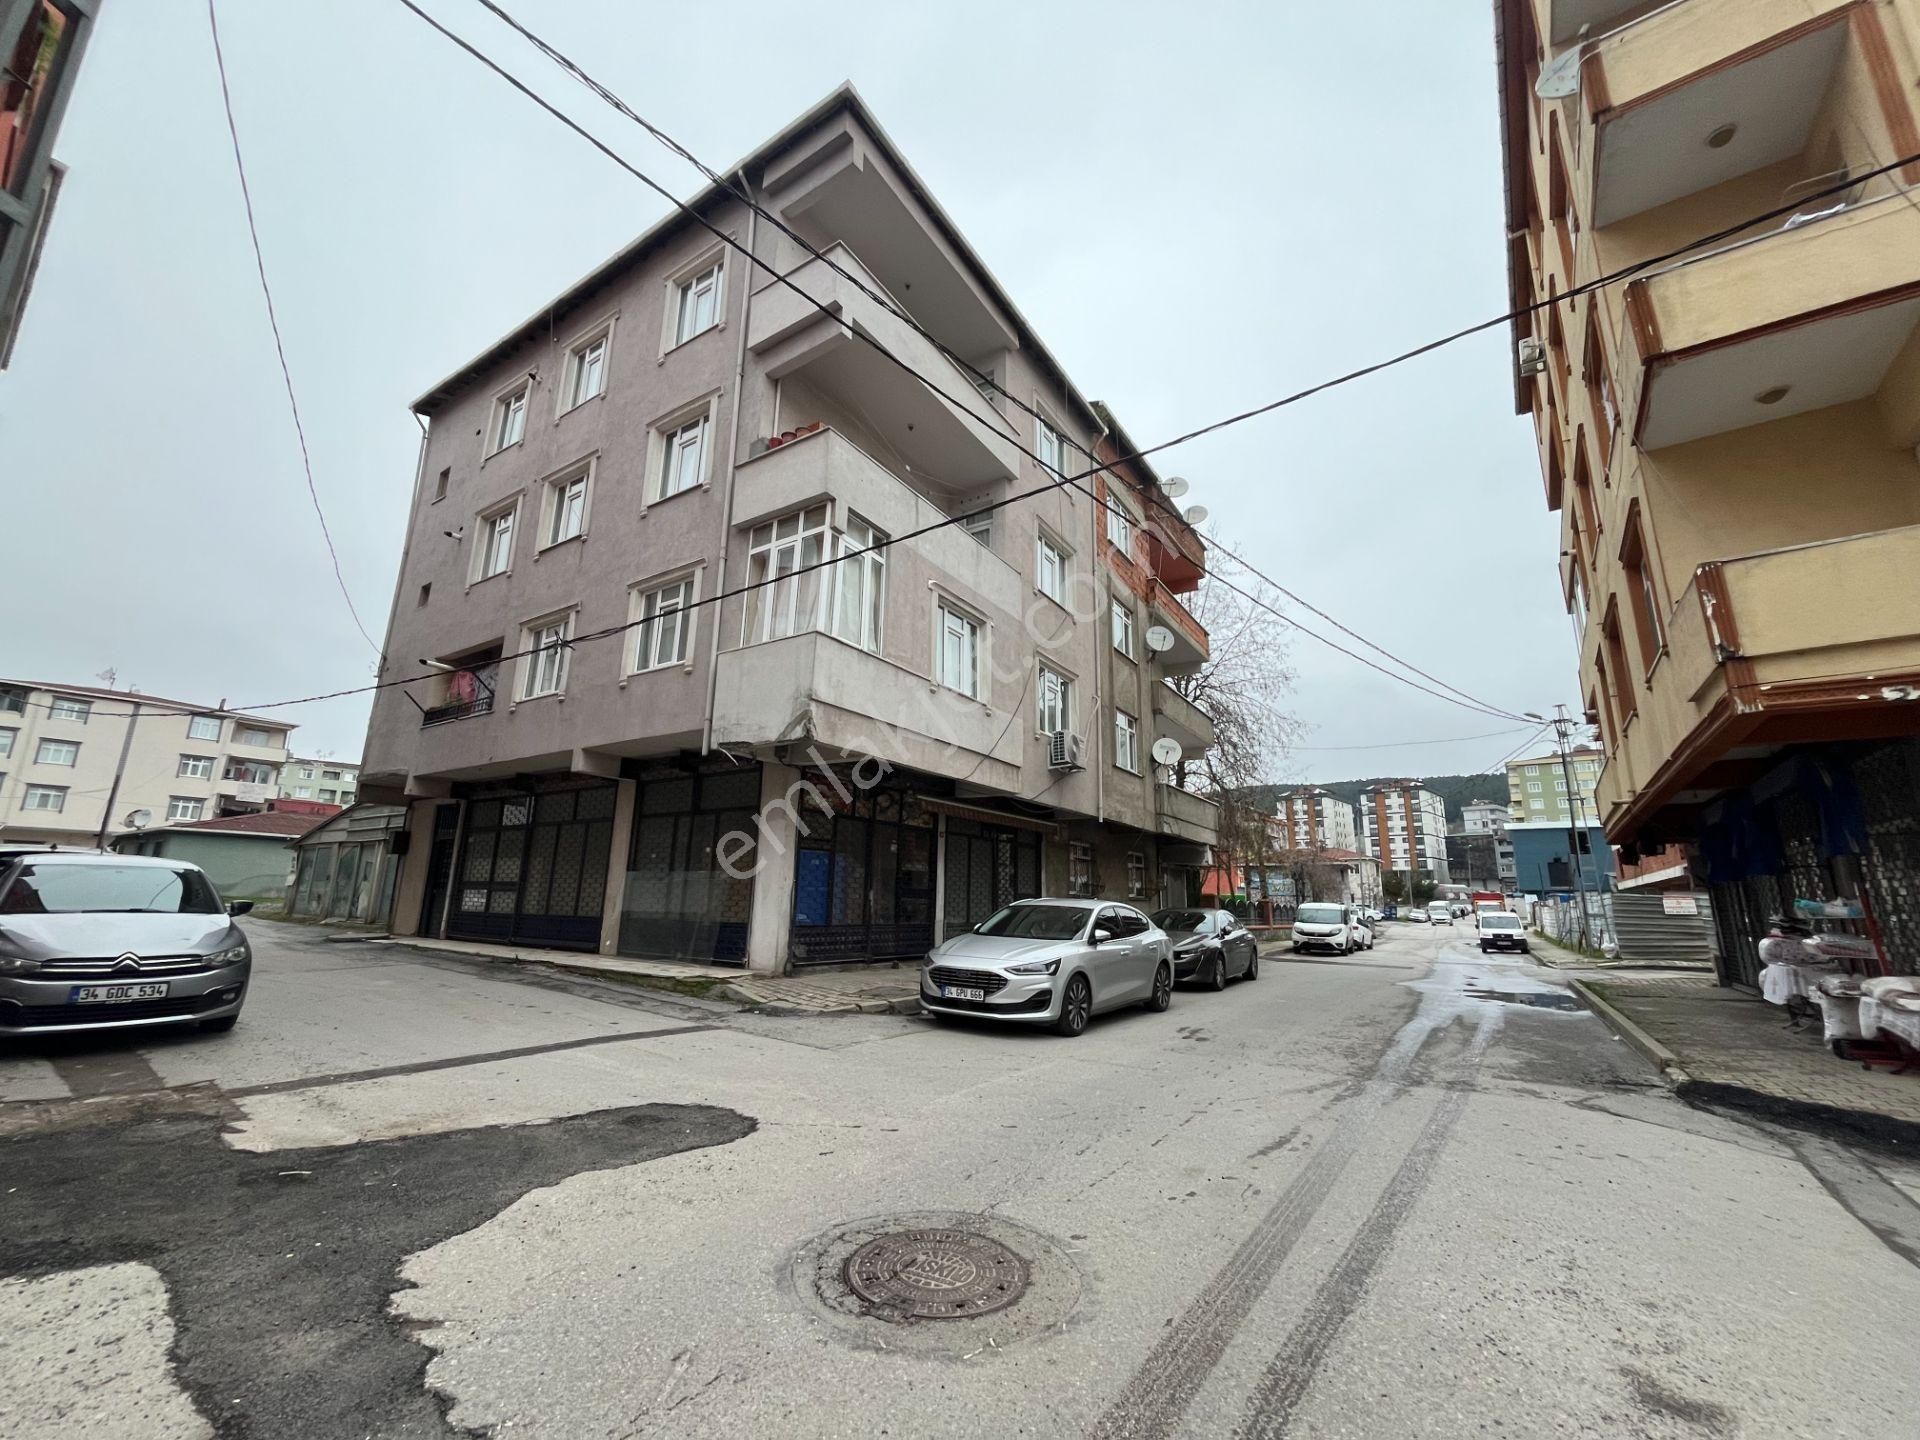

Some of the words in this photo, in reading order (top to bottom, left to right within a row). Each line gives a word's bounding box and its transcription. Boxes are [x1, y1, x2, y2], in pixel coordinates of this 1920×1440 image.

[80, 988, 98, 1000] 34
[106, 987, 133, 999] GDC
[138, 985, 163, 997] 534
